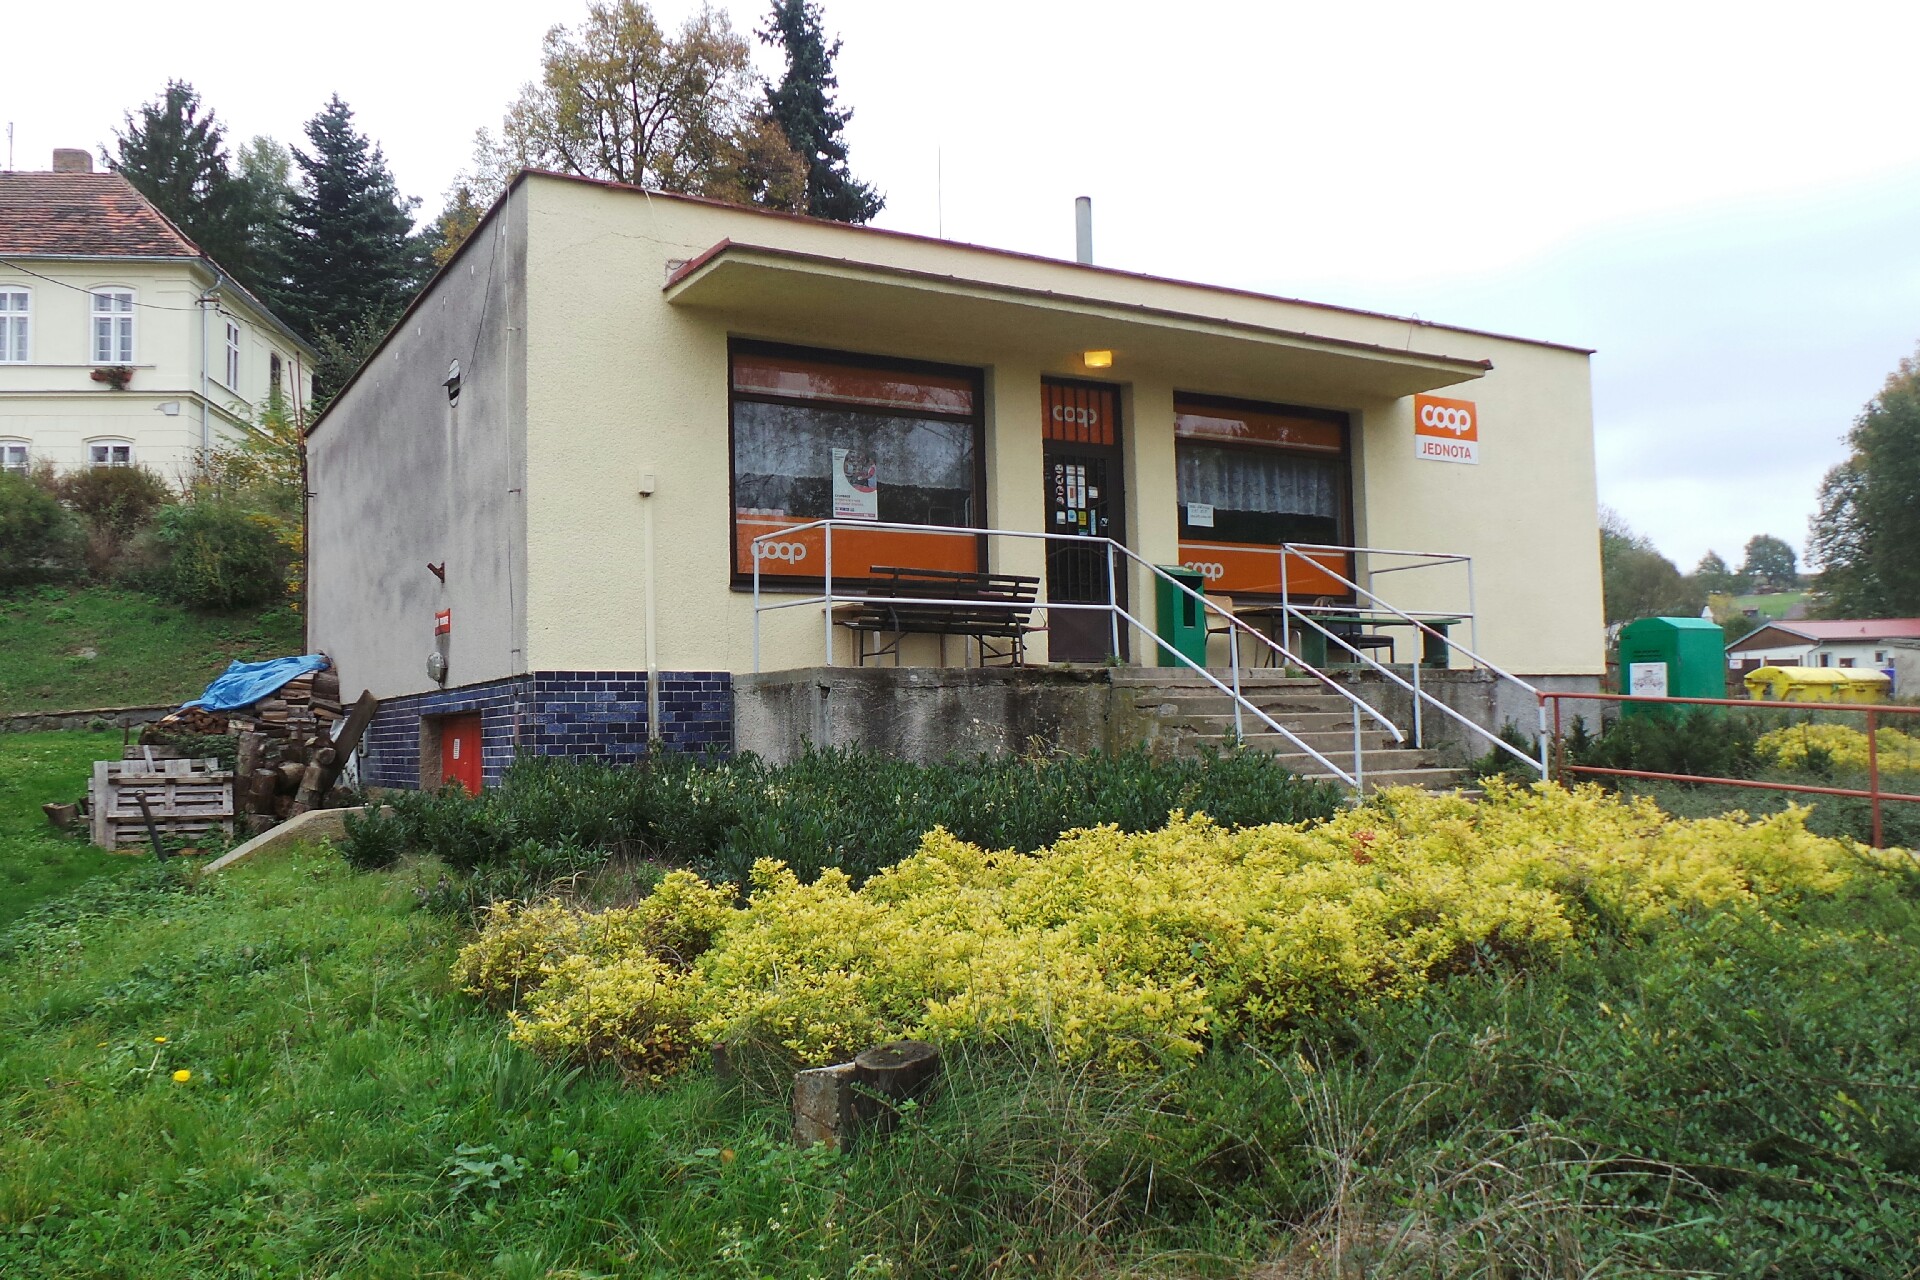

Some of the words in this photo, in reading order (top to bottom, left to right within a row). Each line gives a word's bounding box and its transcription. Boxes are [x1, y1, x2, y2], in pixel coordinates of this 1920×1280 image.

[1053, 405, 1097, 427] coop
[1422, 405, 1471, 435] coop
[1423, 442, 1472, 459] JEDNOTA
[750, 541, 807, 565] coop
